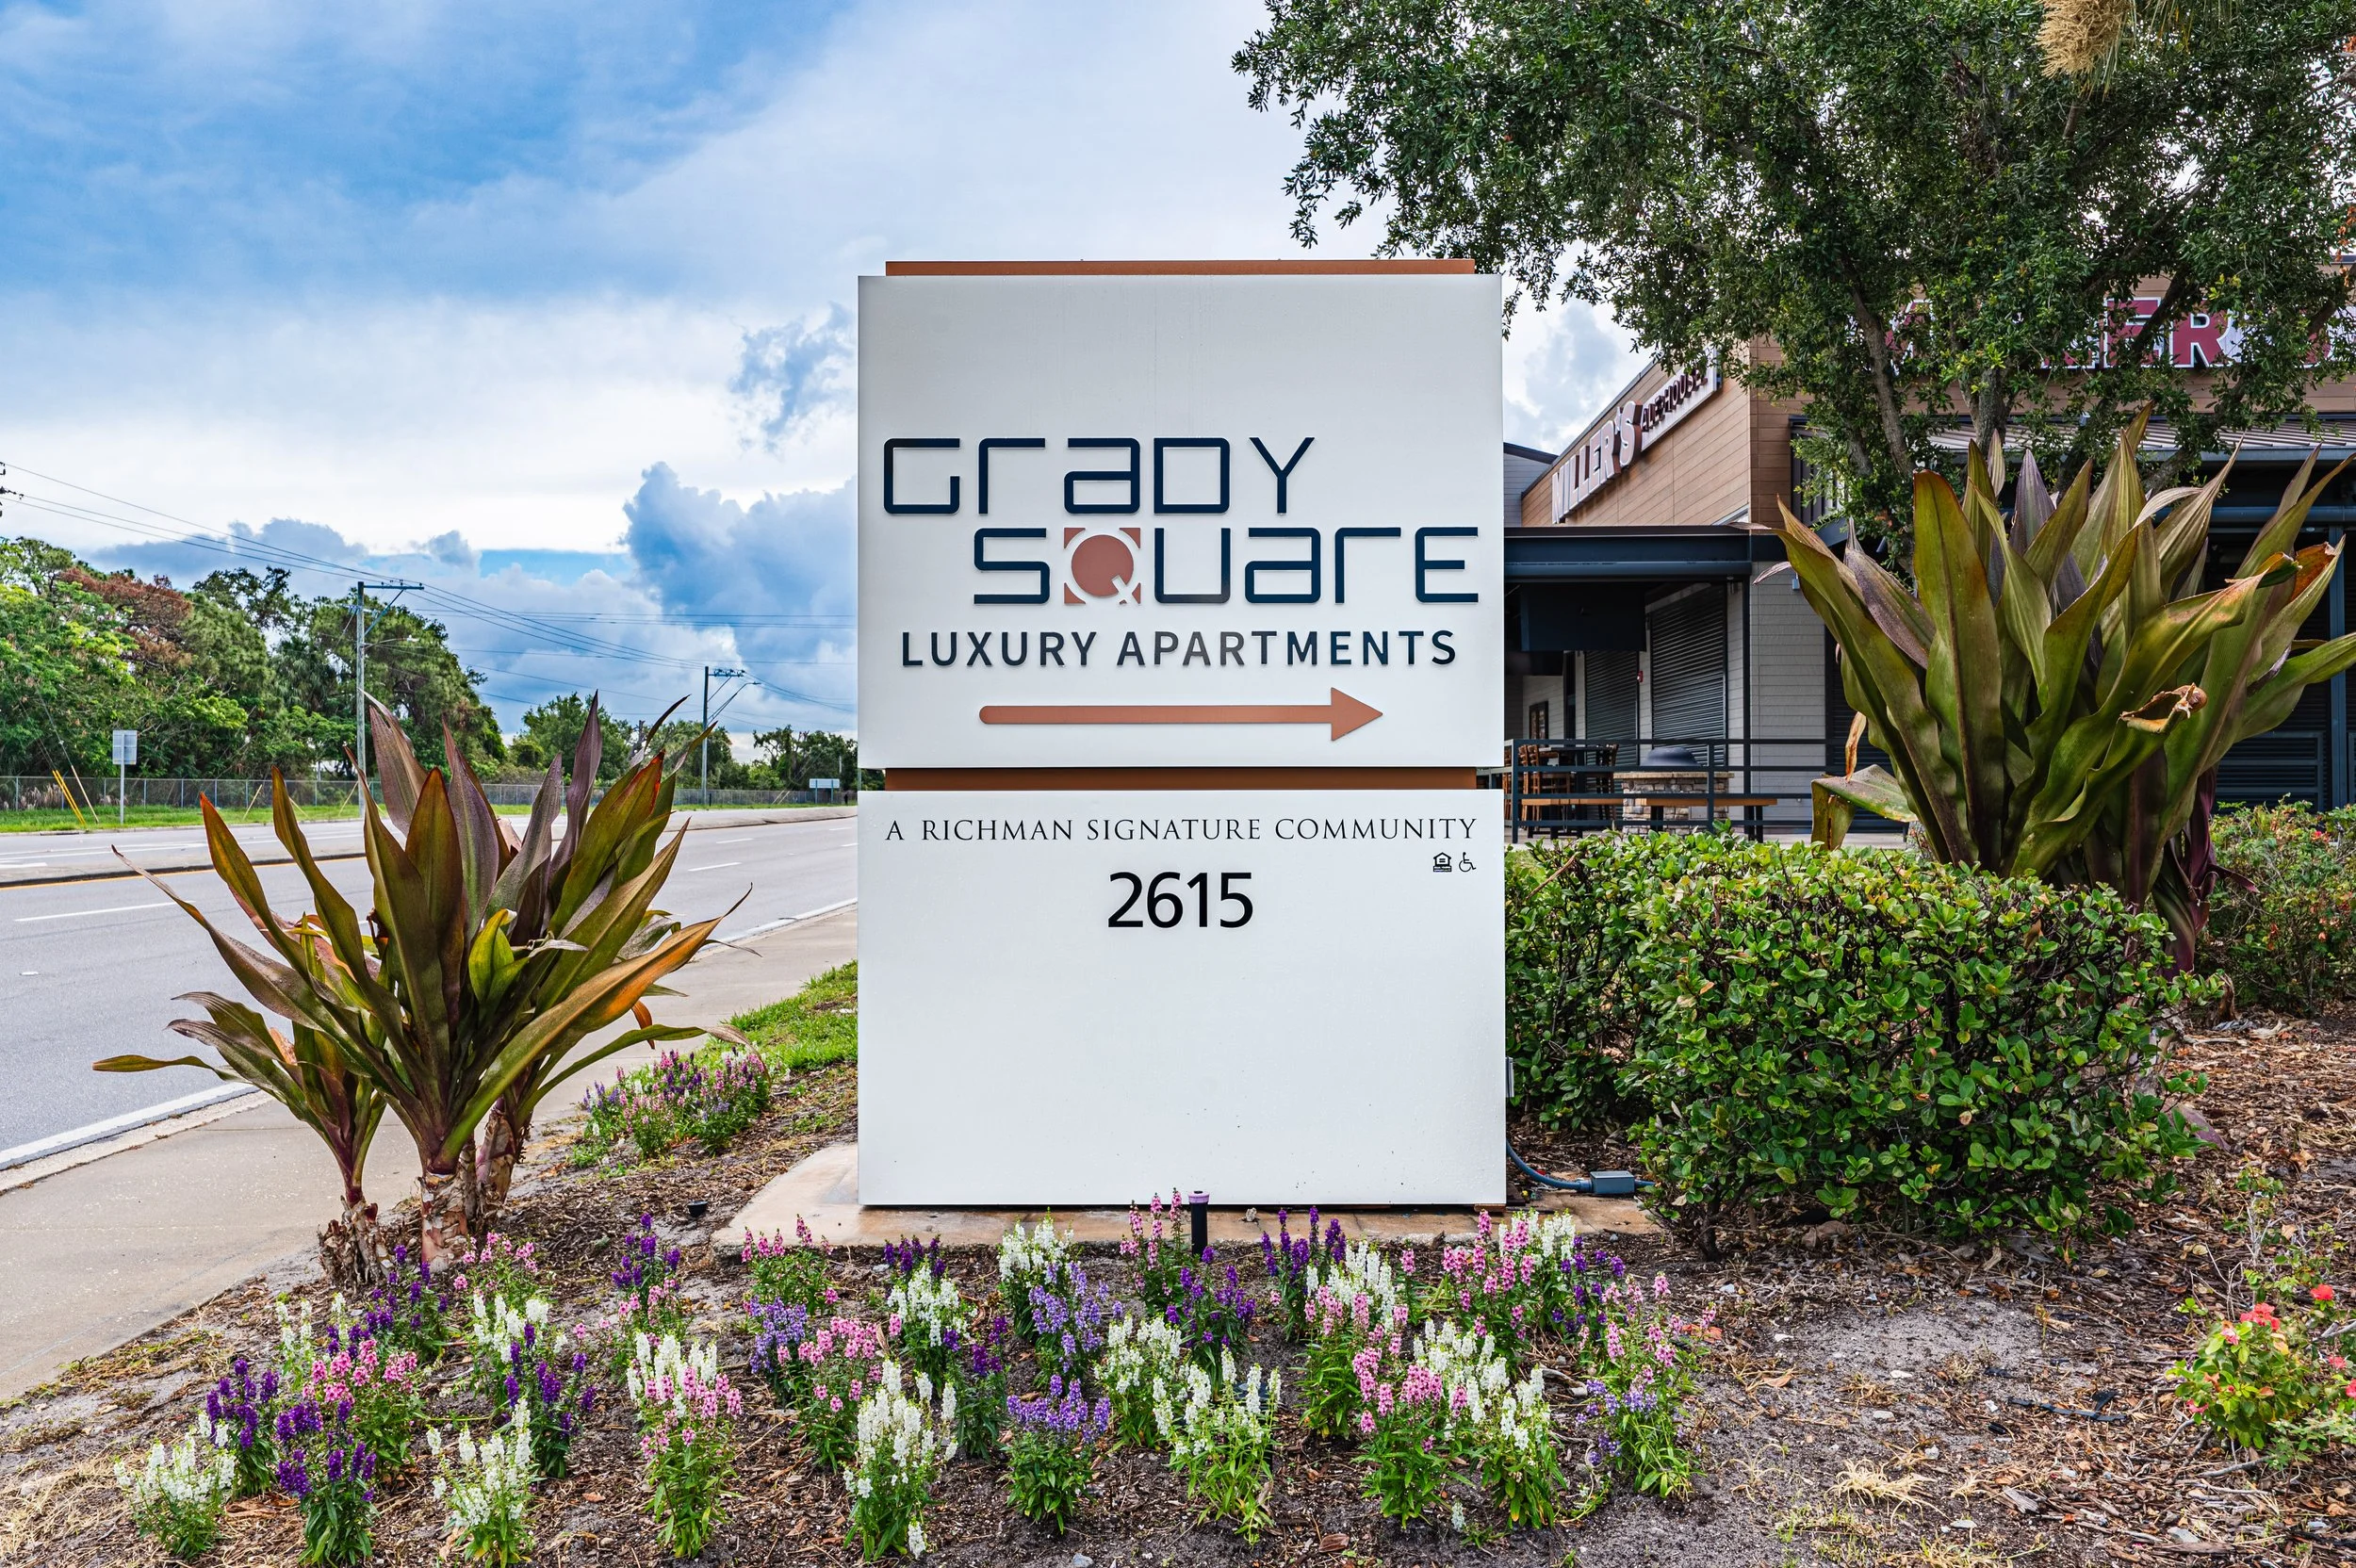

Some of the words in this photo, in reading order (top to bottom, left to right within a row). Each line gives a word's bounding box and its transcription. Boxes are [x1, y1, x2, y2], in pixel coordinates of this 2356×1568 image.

[902, 631, 1097, 668] LUXURY
[1117, 629, 1457, 667] APARTMENTS
[885, 820, 905, 841] A
[922, 819, 1072, 841] RICHMAN
[1087, 819, 1261, 841] SIGNATURE
[1275, 817, 1477, 840] COMMUNITY
[1107, 871, 1253, 929] 2615
